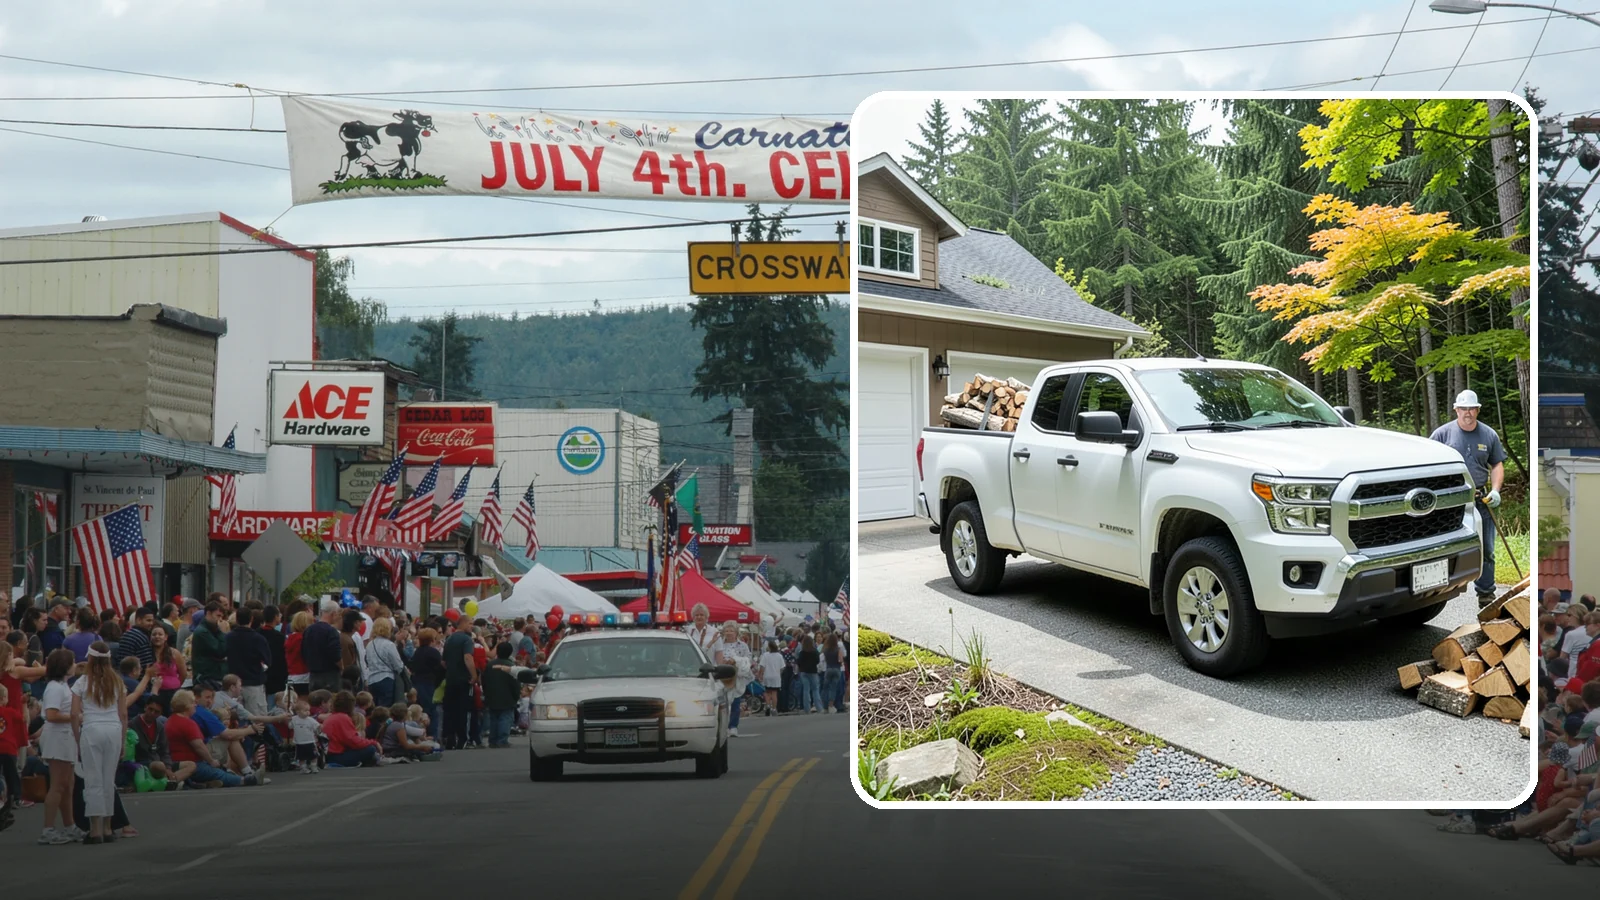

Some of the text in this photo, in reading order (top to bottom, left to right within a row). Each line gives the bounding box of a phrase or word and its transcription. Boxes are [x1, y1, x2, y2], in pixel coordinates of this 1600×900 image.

[481, 141, 605, 192] JULY
[632, 151, 746, 198] 4th.
[696, 255, 850, 280] CROSSWA
[282, 380, 373, 419] ACE
[406, 410, 452, 422] CEDAR
[283, 421, 370, 436] Hardware
[416, 428, 477, 447] Coca-Cola
[353, 467, 386, 480] Simpl
[83, 486, 155, 496] St. Vincent de Paul
[688, 526, 742, 535] CRNATION
[699, 535, 730, 543] GLASS
